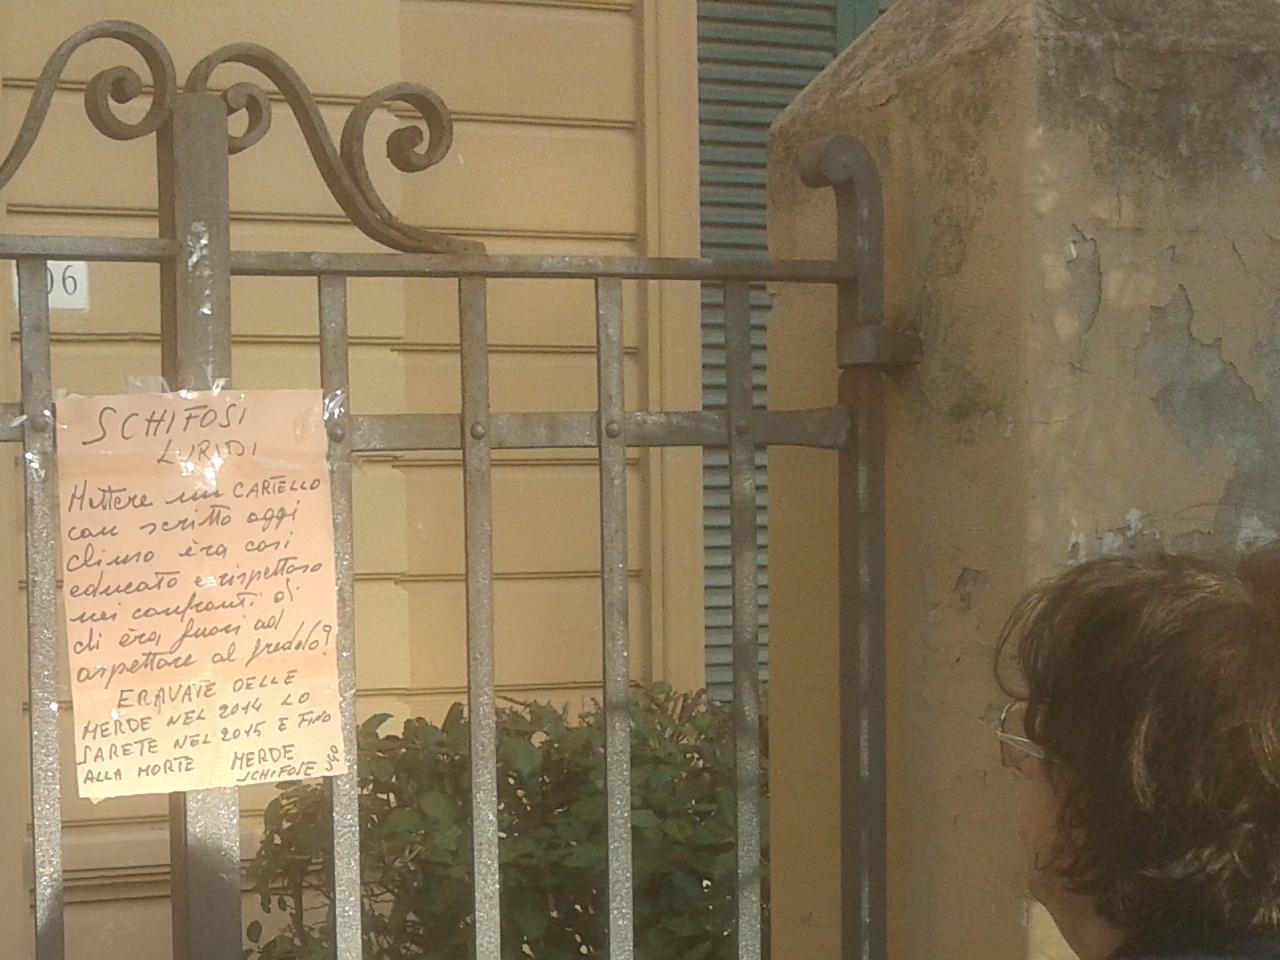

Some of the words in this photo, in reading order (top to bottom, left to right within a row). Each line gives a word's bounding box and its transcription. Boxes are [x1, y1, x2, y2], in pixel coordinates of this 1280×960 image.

[81, 403, 247, 446] SCHIFOSI
[157, 439, 257, 465] LURIDI
[233, 475, 321, 499] CARTELLO
[139, 505, 232, 535] scritto
[247, 500, 301, 532] oggi
[66, 542, 155, 572] chiuso
[69, 570, 181, 598] educato
[219, 556, 323, 590] rispettoso
[69, 602, 122, 623] nei
[132, 591, 263, 623] confronti
[169, 614, 245, 654] fuori
[77, 651, 197, 689] aspettare
[211, 641, 237, 664] al
[117, 680, 217, 711] ERAVATE
[233, 669, 298, 693] DELLE
[82, 716, 153, 740] MERDE
[166, 708, 207, 727] NEL
[218, 697, 263, 719] 2014
[281, 691, 311, 706] LO
[77, 738, 159, 765] SARETE
[173, 733, 212, 749] NEL
[220, 720, 266, 742] 2015
[278, 717, 289, 732] E
[298, 710, 332, 728] FINO
[83, 768, 122, 784] ALLA
[138, 756, 195, 778] MORTE
[231, 744, 295, 770] MERDE
[236, 761, 318, 782] SCHIFOSE
